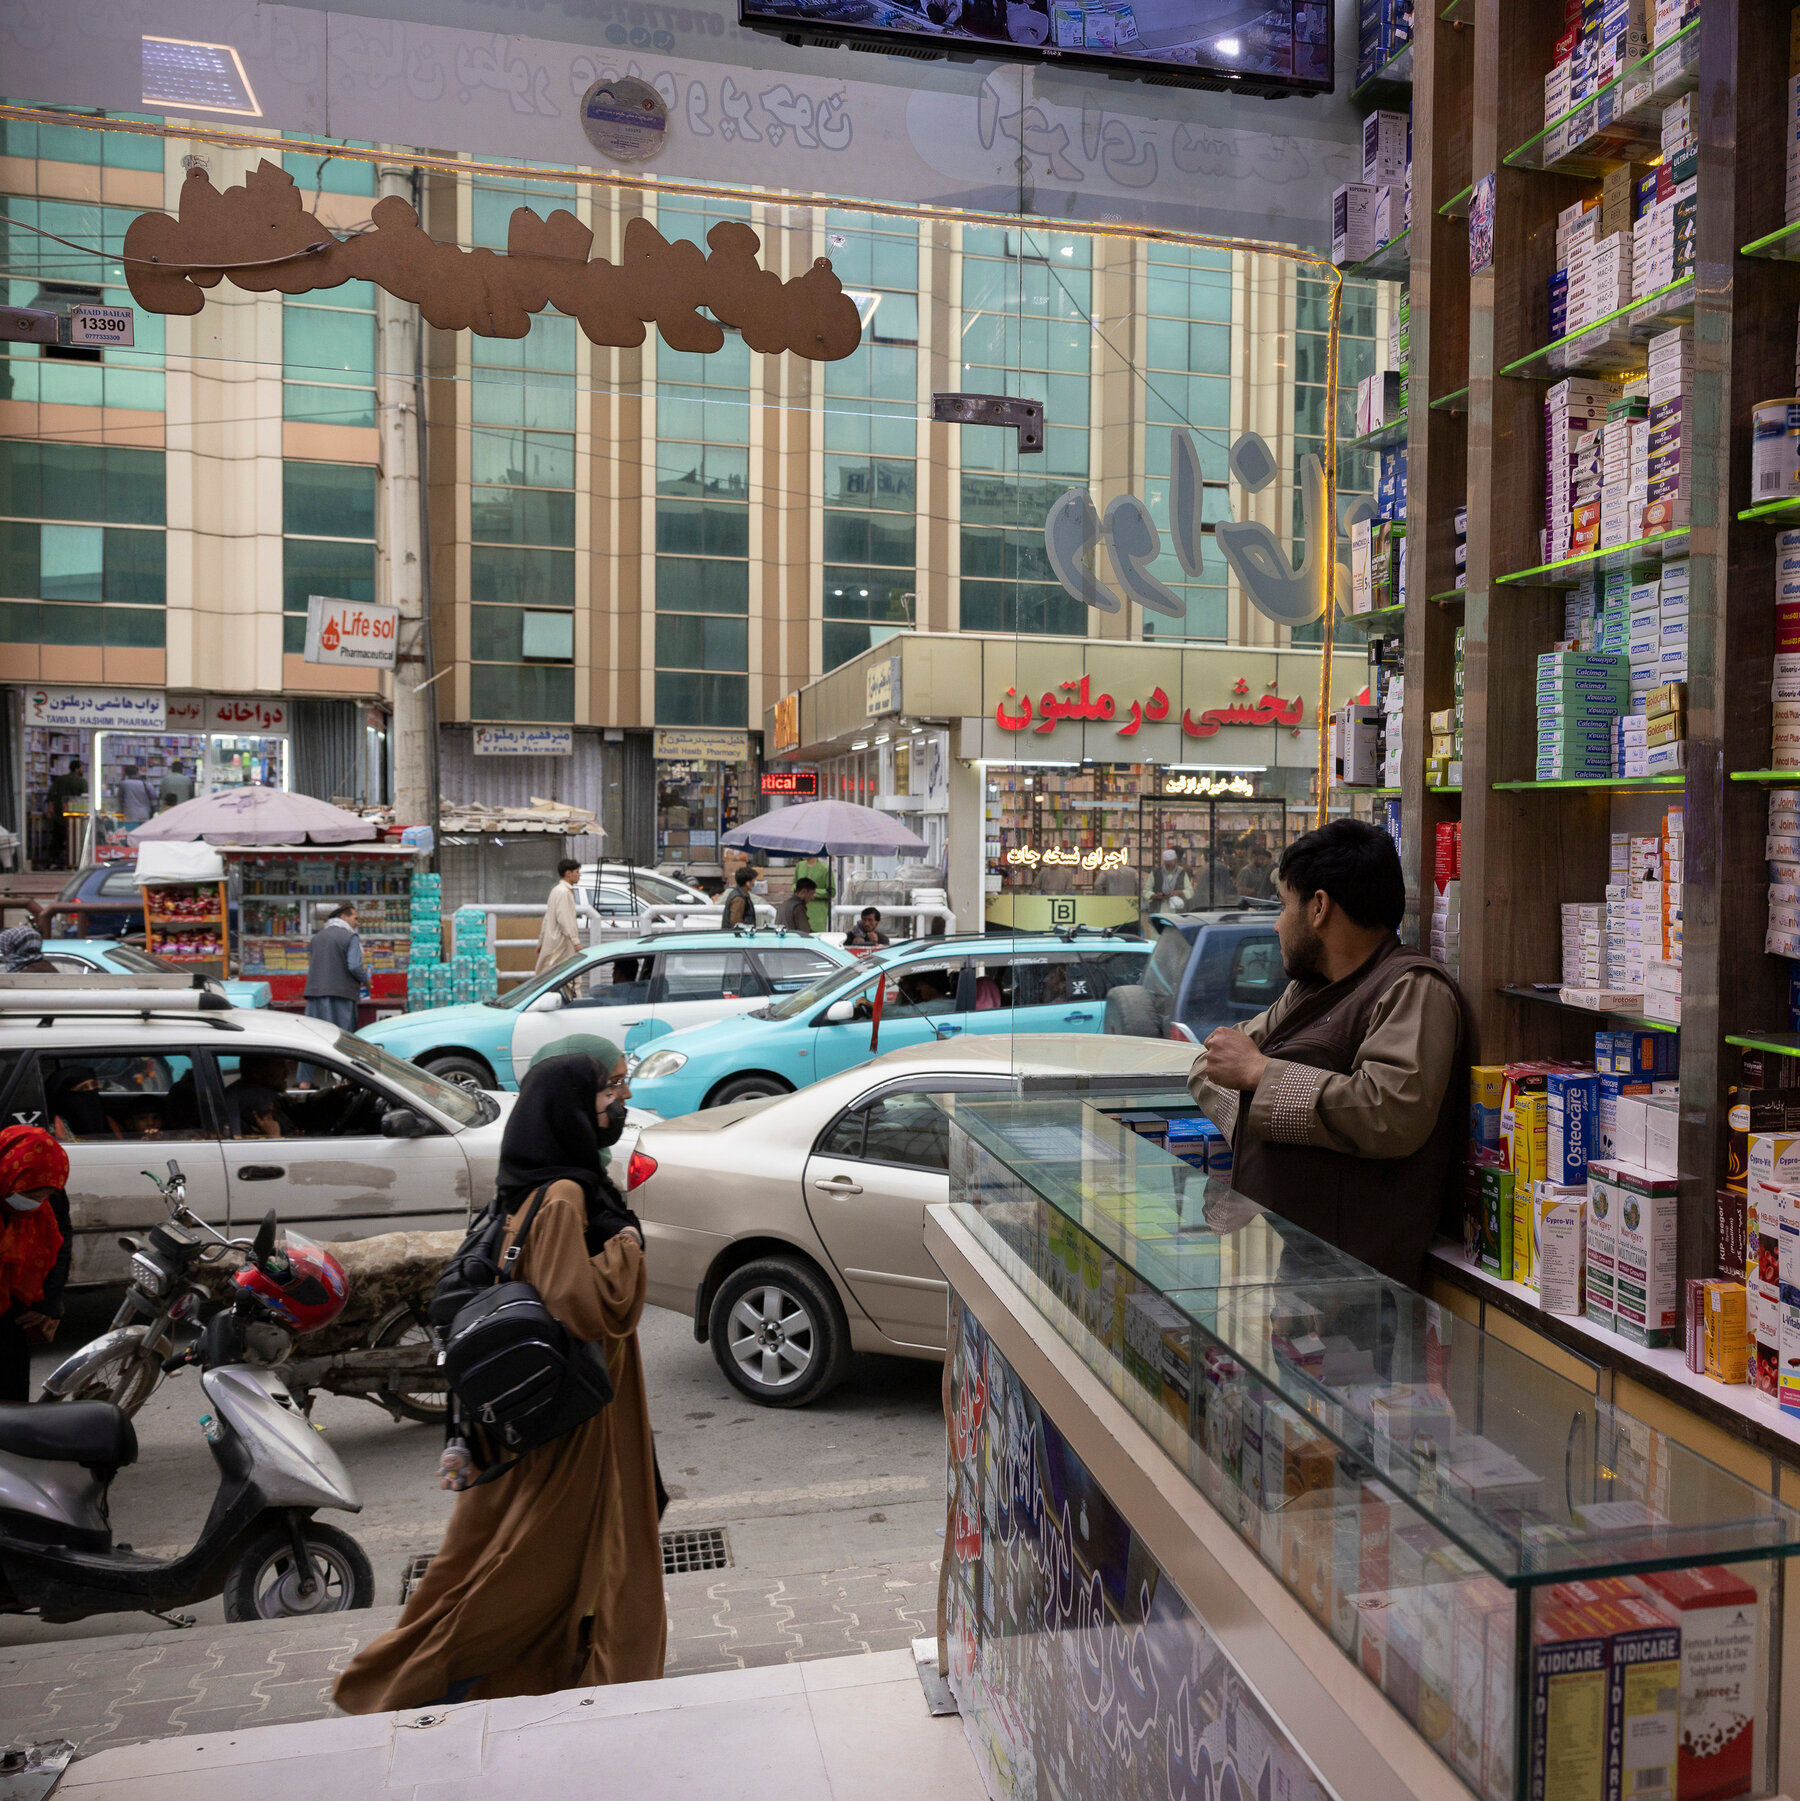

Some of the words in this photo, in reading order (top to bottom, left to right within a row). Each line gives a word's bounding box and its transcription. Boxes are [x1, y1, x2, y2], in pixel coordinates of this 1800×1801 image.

[1596, 239, 1612, 252] MAC-D
[1598, 252, 1613, 265] MAC-D
[1597, 265, 1613, 278] MAC-D
[1597, 278, 1613, 290] MAC-D
[1597, 291, 1613, 304] MAC-D
[1596, 304, 1612, 316] MAC-D
[81, 317, 125, 331] 13390
[341, 610, 369, 637] Life
[372, 615, 396, 639] sol
[340, 646, 394, 660] Pharmaceutical
[1586, 656, 1617, 664] Calcimax
[1576, 668, 1607, 677] Calcimax
[134, 697, 160, 713] تواب
[1647, 692, 1668, 707] Goldcare
[1181, 677, 1304, 739] بخشی
[46, 715, 76, 724] TAWAB
[79, 716, 114, 725] HASHIMI
[117, 717, 165, 727] PHARMACY
[216, 702, 283, 729] دواخانه
[1577, 720, 1608, 728] Calcimax
[1648, 721, 1673, 737] Goldcare
[658, 747, 679, 755] Khalil
[706, 748, 741, 758] Pharmacy
[1006, 845, 1041, 869] جات
[1042, 845, 1081, 866] نسخه
[1082, 846, 1128, 871] اجرای
[1567, 1088, 1582, 1167] Osteocare
[1750, 1154, 1771, 1167] Cypro-Vit
[1546, 1217, 1574, 1225] Cypro-Vit
[1613, 1639, 1677, 1664] KIDICARE
[1688, 1652, 1705, 1663] Folic
[1707, 1651, 1724, 1661] Acid
[1538, 1650, 1604, 1672] KIDICARE
[1724, 1662, 1746, 1675] Syrup
